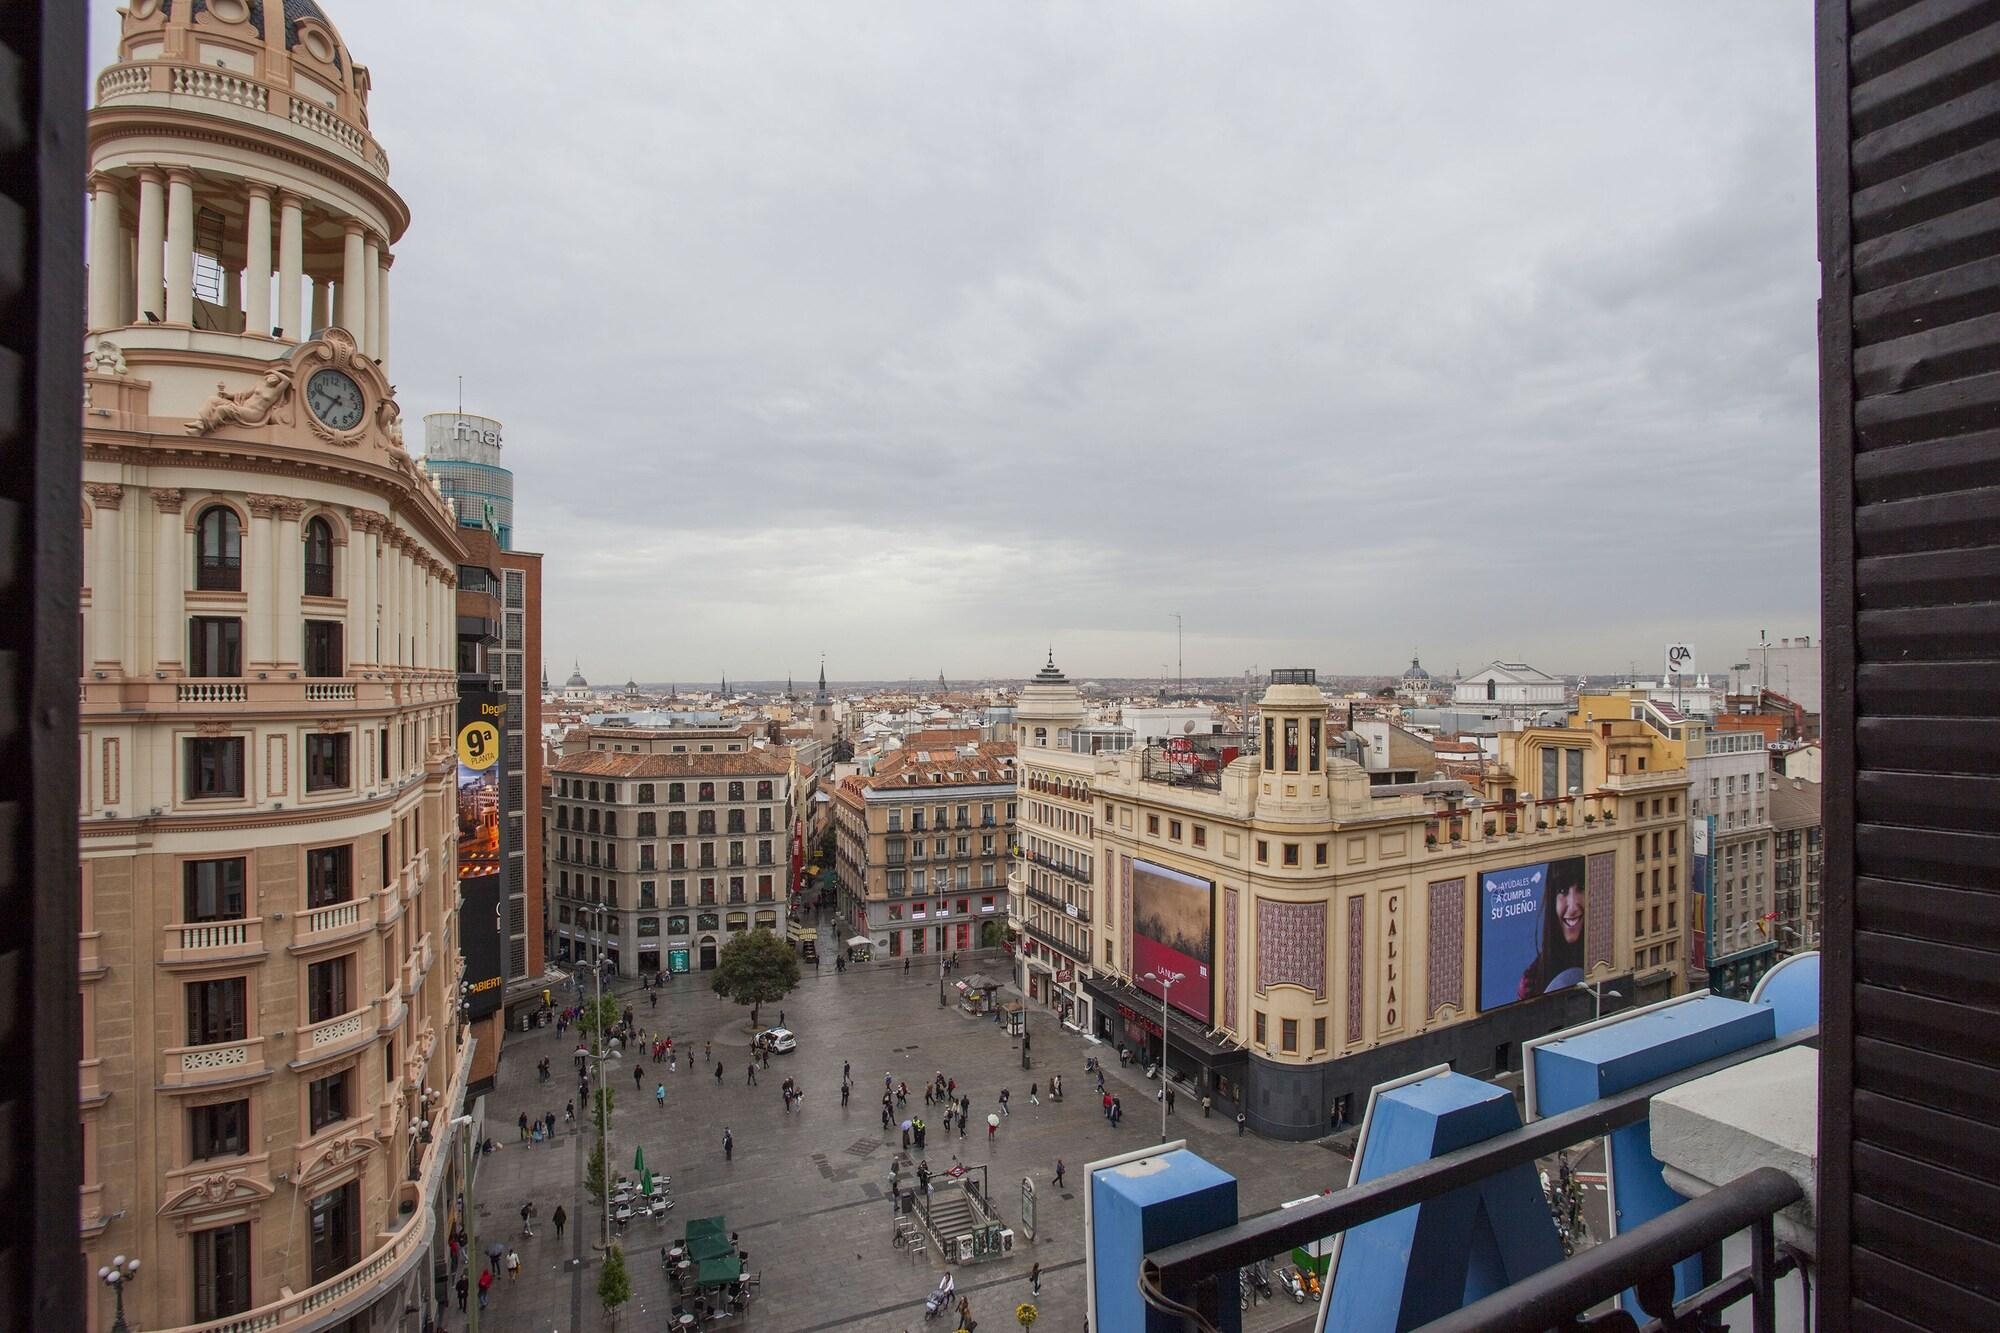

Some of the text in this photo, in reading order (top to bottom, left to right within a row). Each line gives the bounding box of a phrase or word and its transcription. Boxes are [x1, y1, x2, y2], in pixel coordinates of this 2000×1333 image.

[1503, 889, 1532, 902] CUMPLIR
[1491, 900, 1537, 920] SU SUEÑO!
[1387, 896, 1397, 1025] CALLAO
